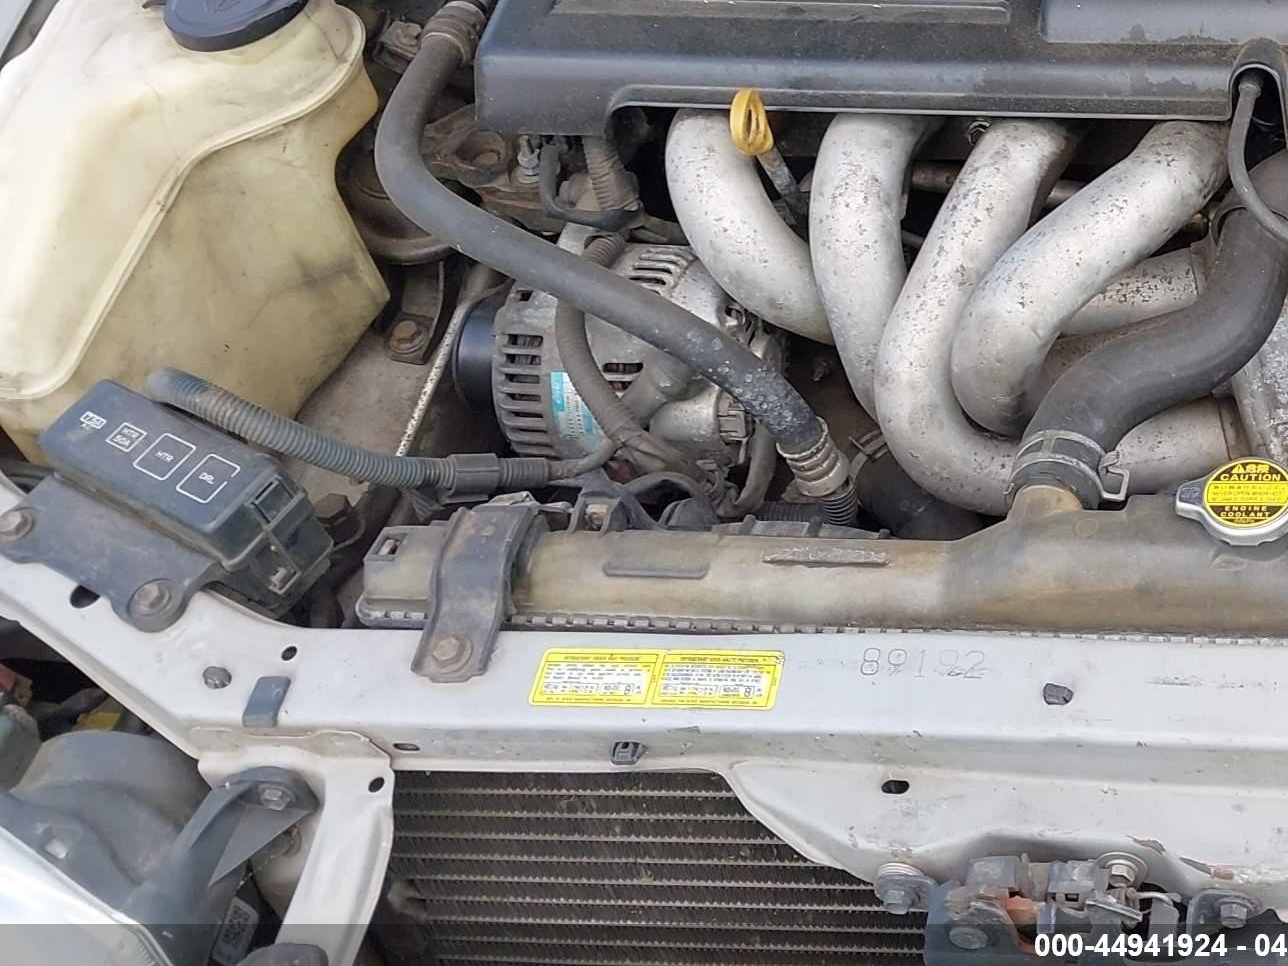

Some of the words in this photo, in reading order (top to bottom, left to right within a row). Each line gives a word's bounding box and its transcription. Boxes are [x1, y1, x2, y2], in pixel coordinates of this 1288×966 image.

[121, 427, 141, 438] HTR
[113, 434, 131, 448] 50A
[155, 450, 174, 464] HTR
[198, 471, 216, 485] DRL
[1220, 473, 1281, 481] CAUTION
